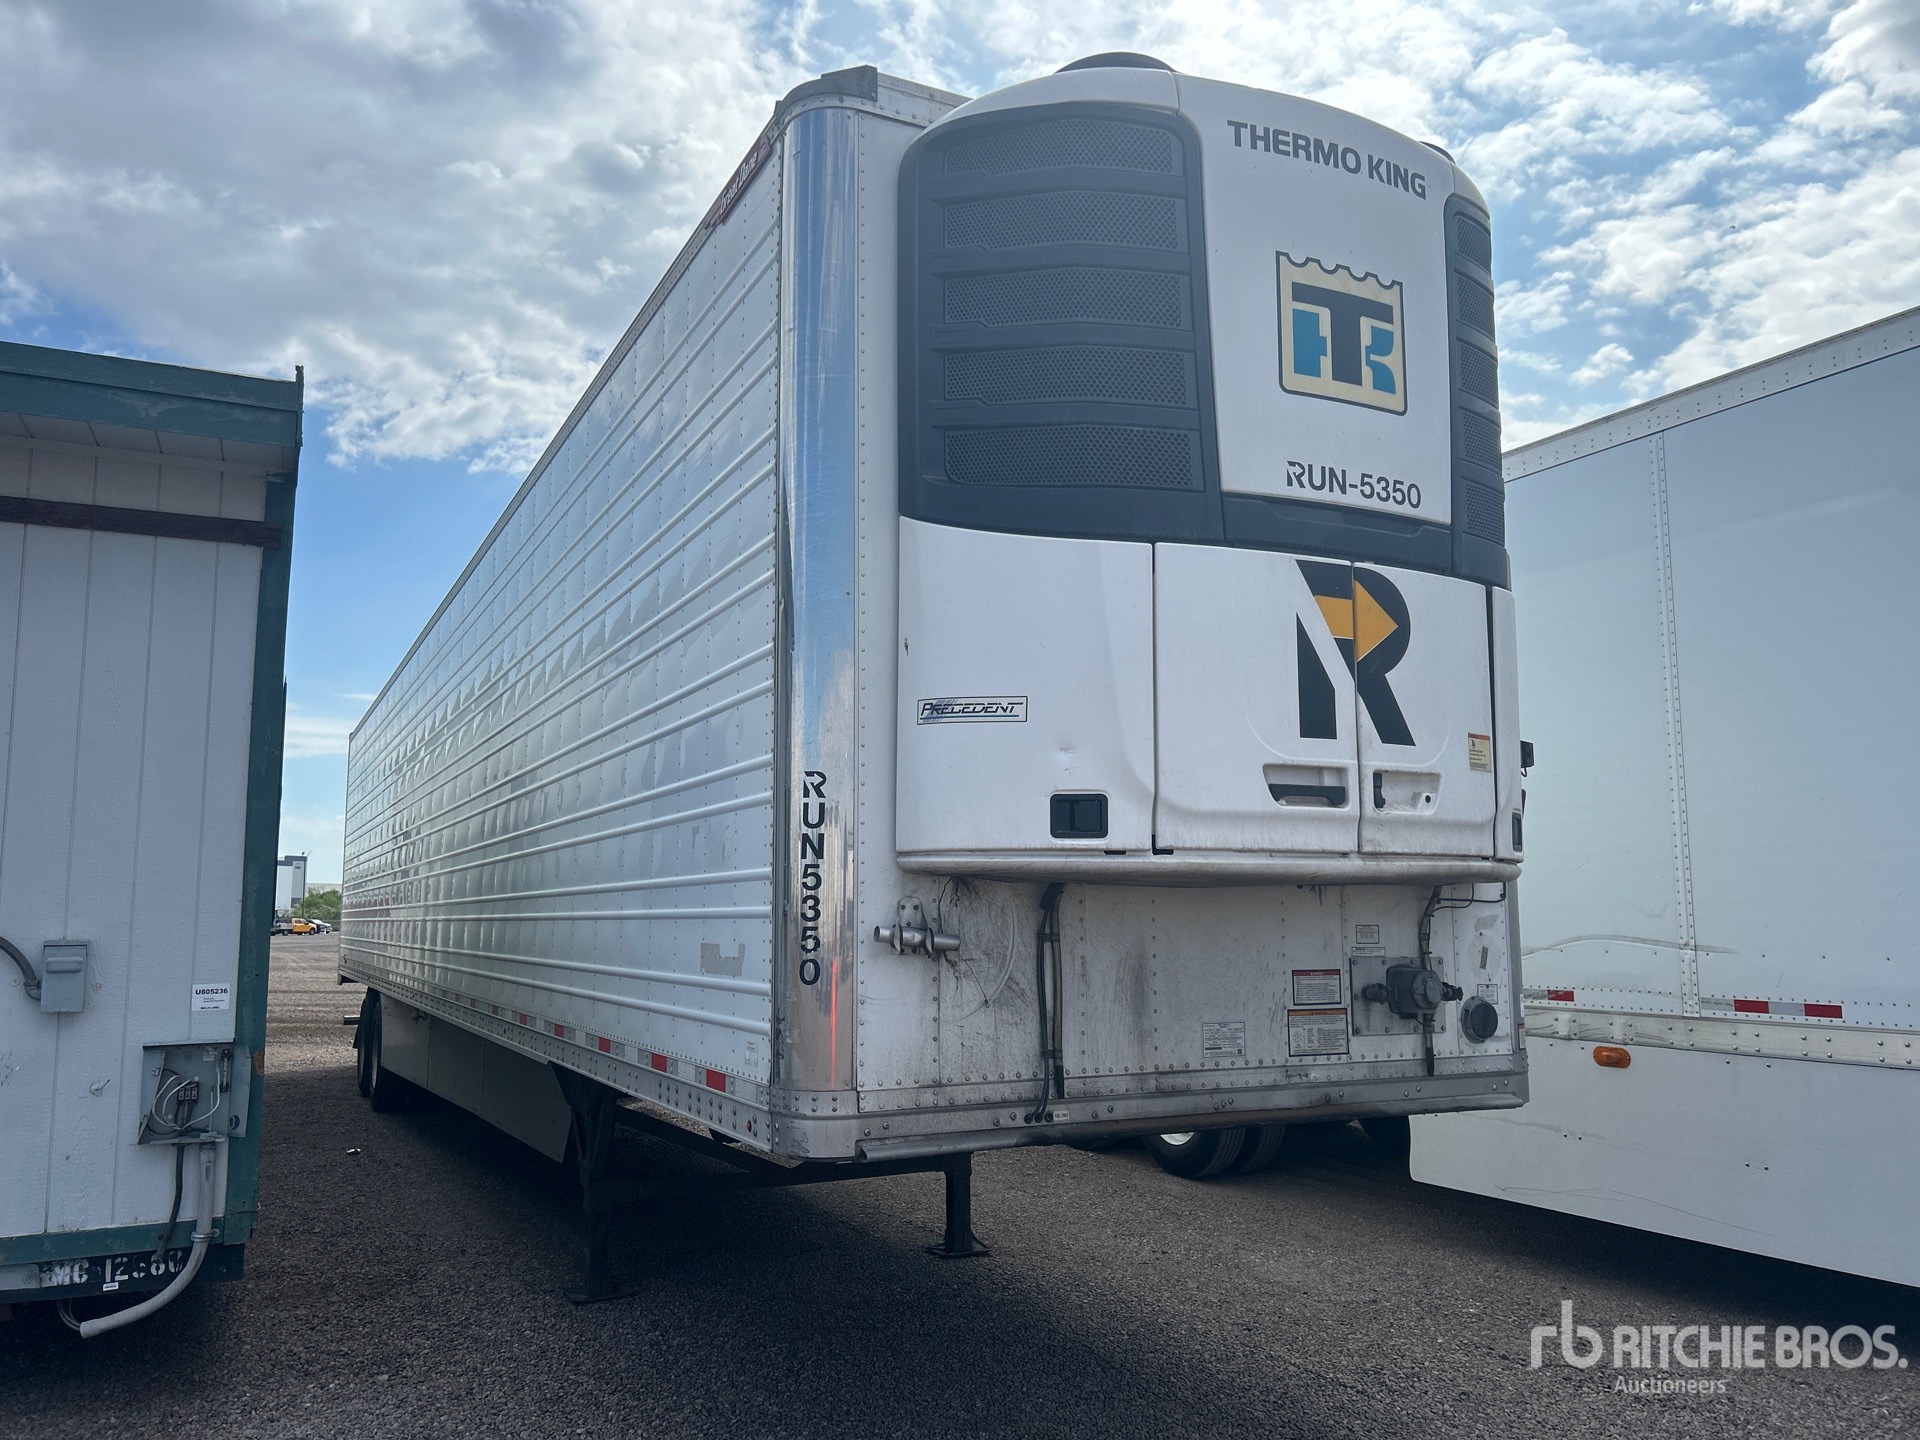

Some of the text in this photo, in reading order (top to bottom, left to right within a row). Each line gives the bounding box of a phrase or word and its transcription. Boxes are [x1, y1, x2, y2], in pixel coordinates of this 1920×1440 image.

[1227, 119, 1426, 200] THERMO KING
[1286, 460, 1421, 509] RUN-5350
[920, 702, 1024, 716] PRECEDENT
